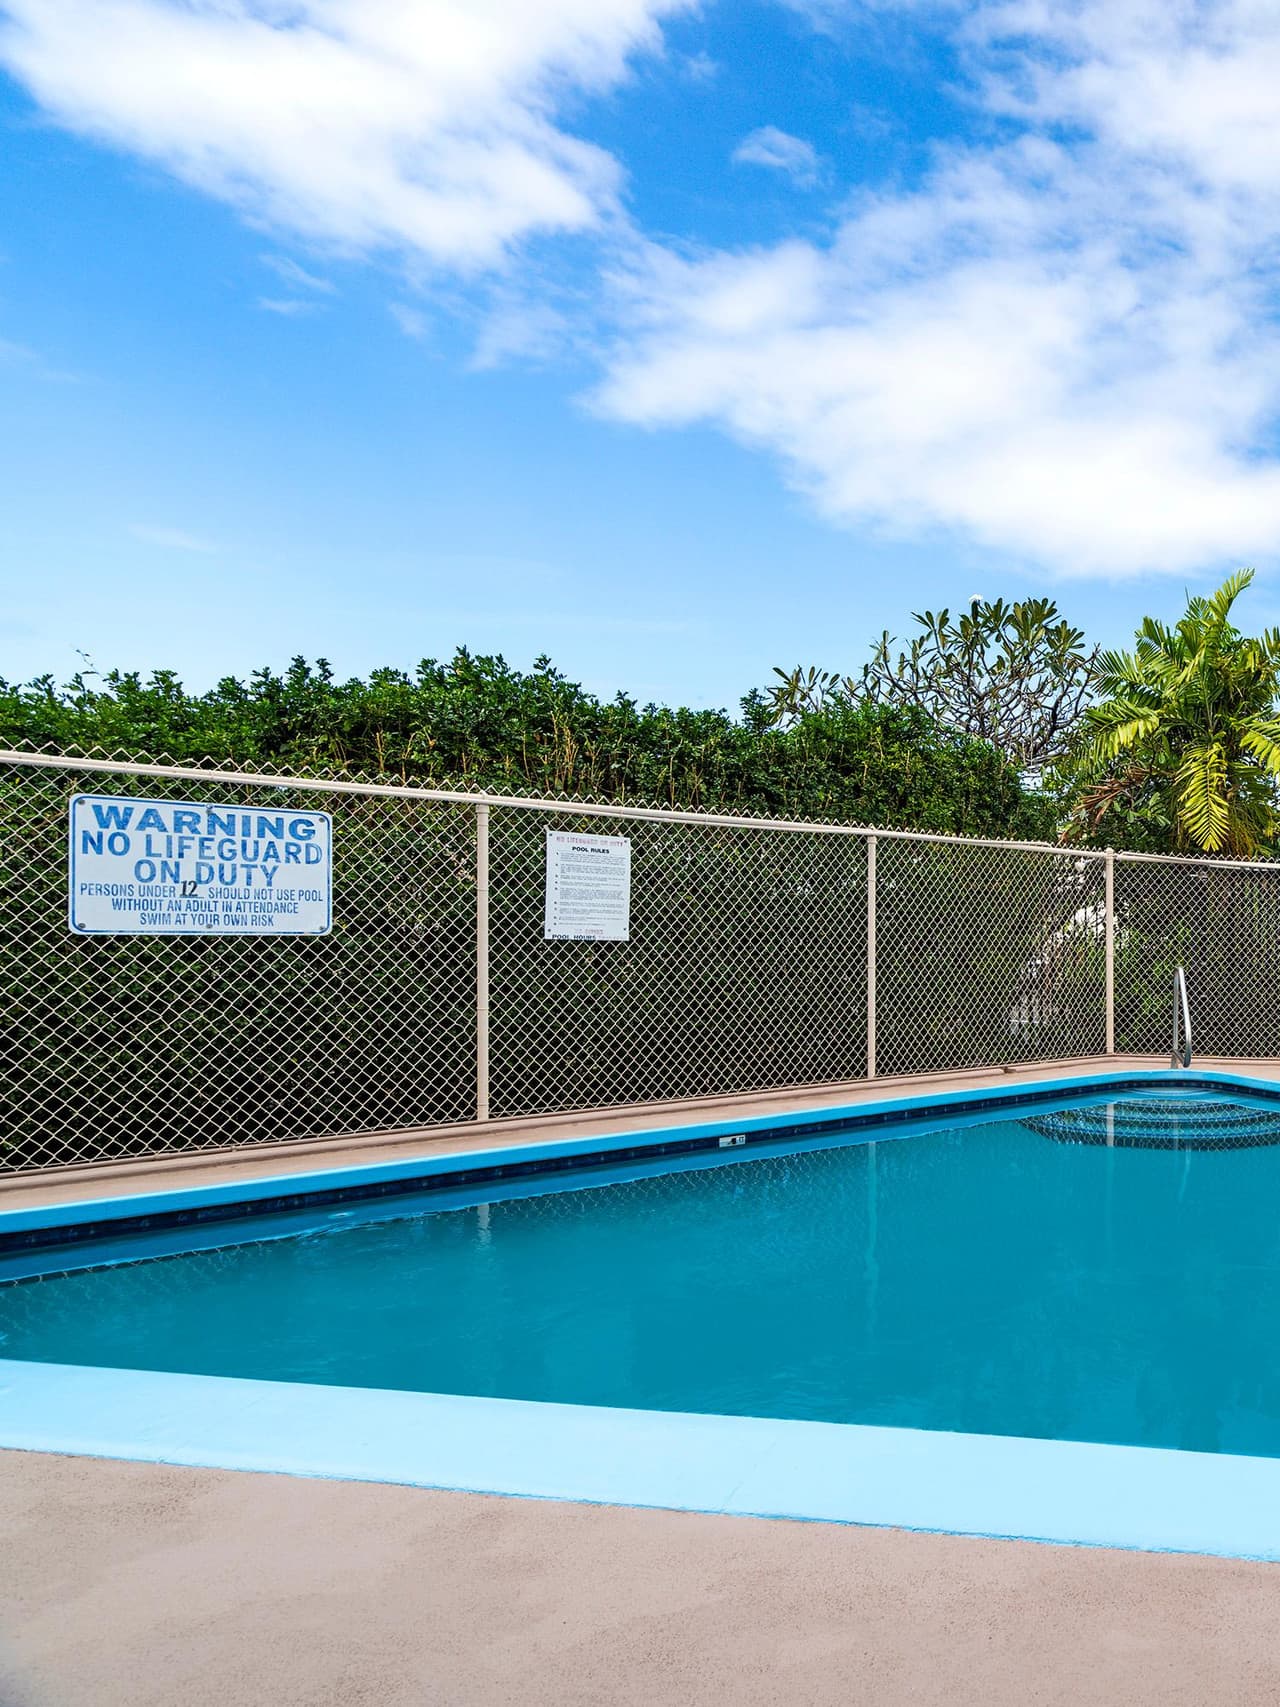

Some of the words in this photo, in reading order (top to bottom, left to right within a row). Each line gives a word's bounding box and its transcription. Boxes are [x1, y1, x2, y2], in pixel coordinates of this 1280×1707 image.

[91, 804, 317, 841] WARNING
[81, 830, 131, 857] NO
[144, 833, 323, 865] LIFEGUARD
[134, 859, 180, 884] ON
[195, 861, 280, 887] DUTY
[80, 883, 135, 898] PERSONS
[138, 884, 176, 899] UNDER
[179, 880, 199, 898] 12
[208, 887, 250, 901] SHOULD
[253, 888, 275, 901] NOT
[276, 889, 296, 901] USE
[298, 889, 323, 902] POOL
[112, 898, 165, 912] WITHOUT
[166, 899, 182, 912] AN
[185, 900, 218, 913] ADULT
[222, 901, 234, 913] IN
[235, 901, 299, 914] ATTENDANCE
[139, 912, 172, 926] SWIM
[174, 913, 188, 926] AT
[190, 913, 220, 926] YOUR
[223, 914, 248, 927] OWN
[251, 914, 274, 927] RISK
